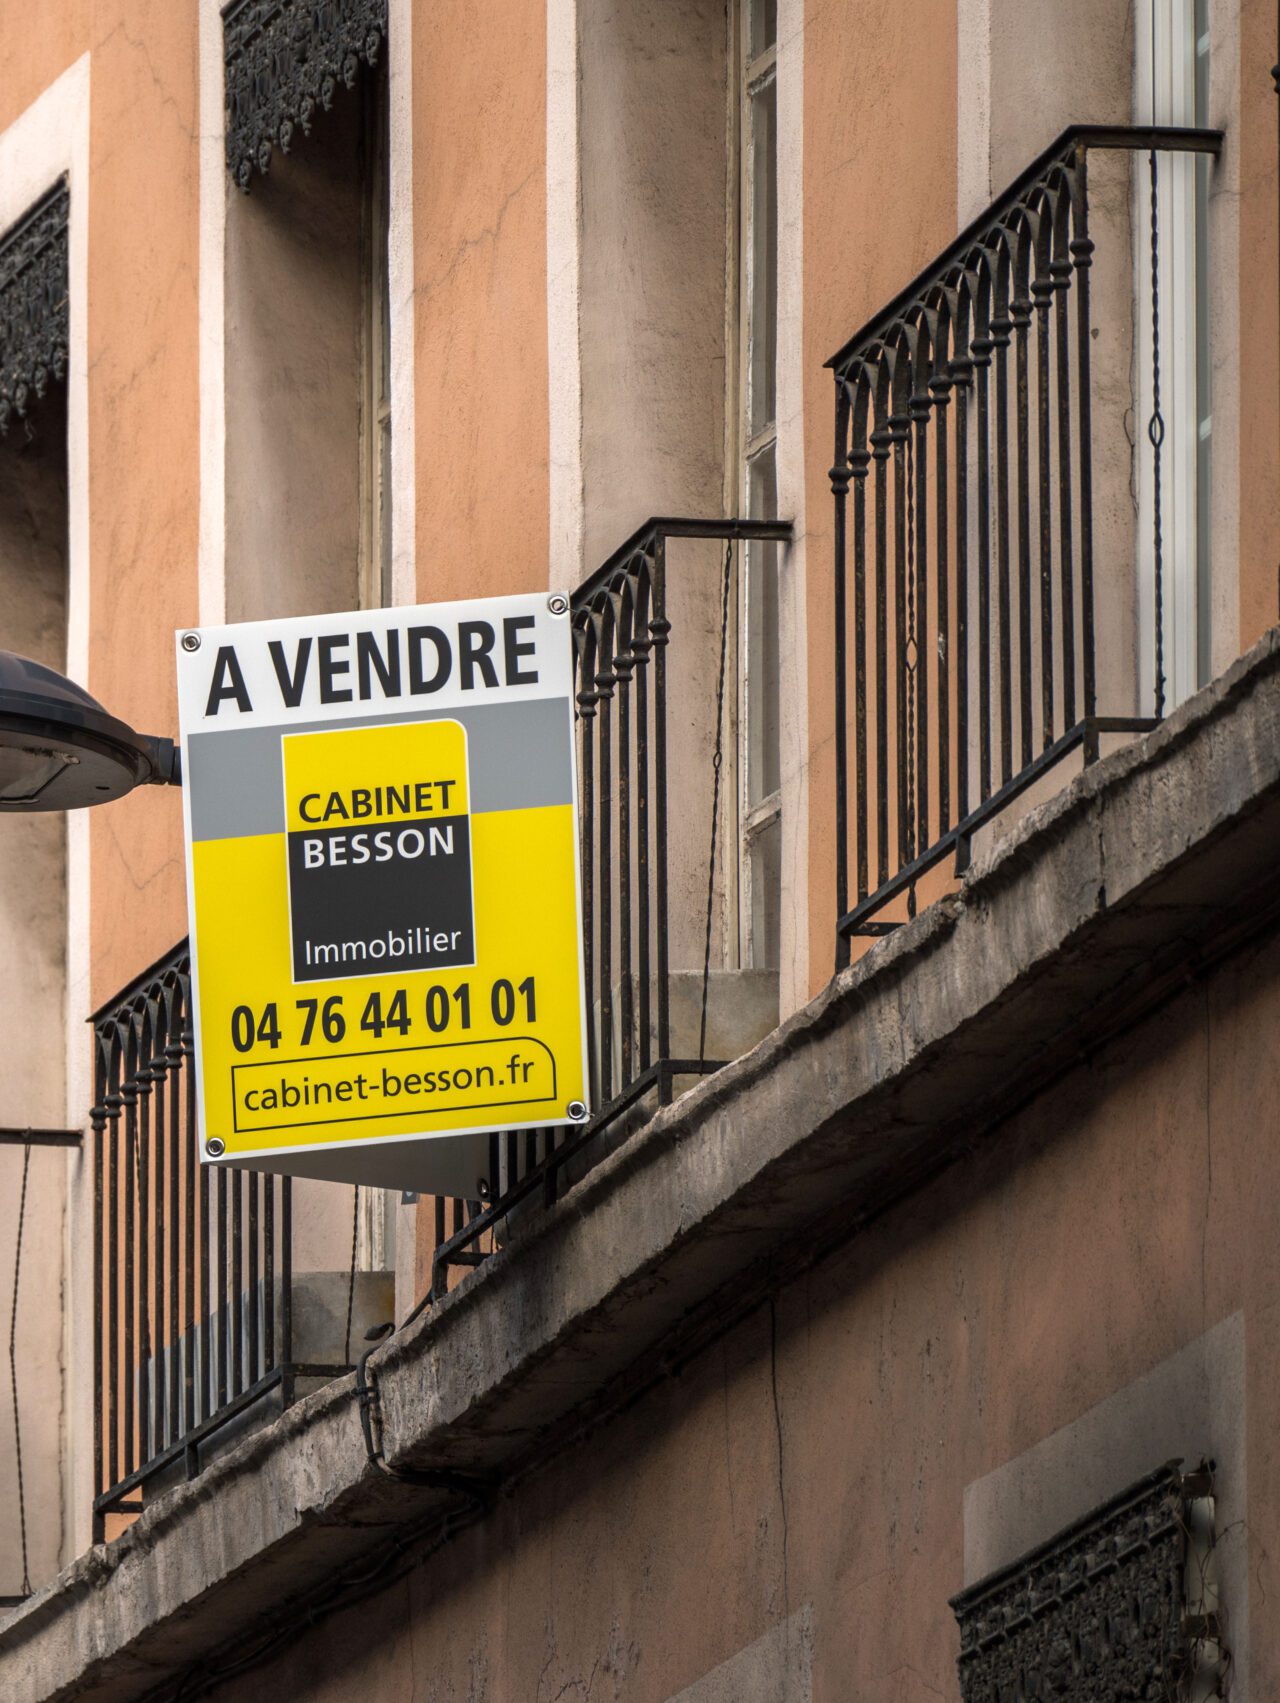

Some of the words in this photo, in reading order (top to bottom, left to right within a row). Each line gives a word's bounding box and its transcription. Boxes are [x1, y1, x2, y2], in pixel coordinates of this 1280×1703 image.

[204, 645, 253, 717] A
[267, 615, 539, 708] VENDRE
[298, 780, 456, 823] CABINET
[303, 825, 454, 869] BESSON
[305, 927, 462, 966] Immobilier
[231, 1002, 282, 1053] 04
[295, 995, 346, 1046] 76
[360, 989, 412, 1039] 44
[425, 983, 472, 1033] 01
[490, 976, 537, 1026] 01
[243, 1053, 535, 1112] cabinet-besson.fr
